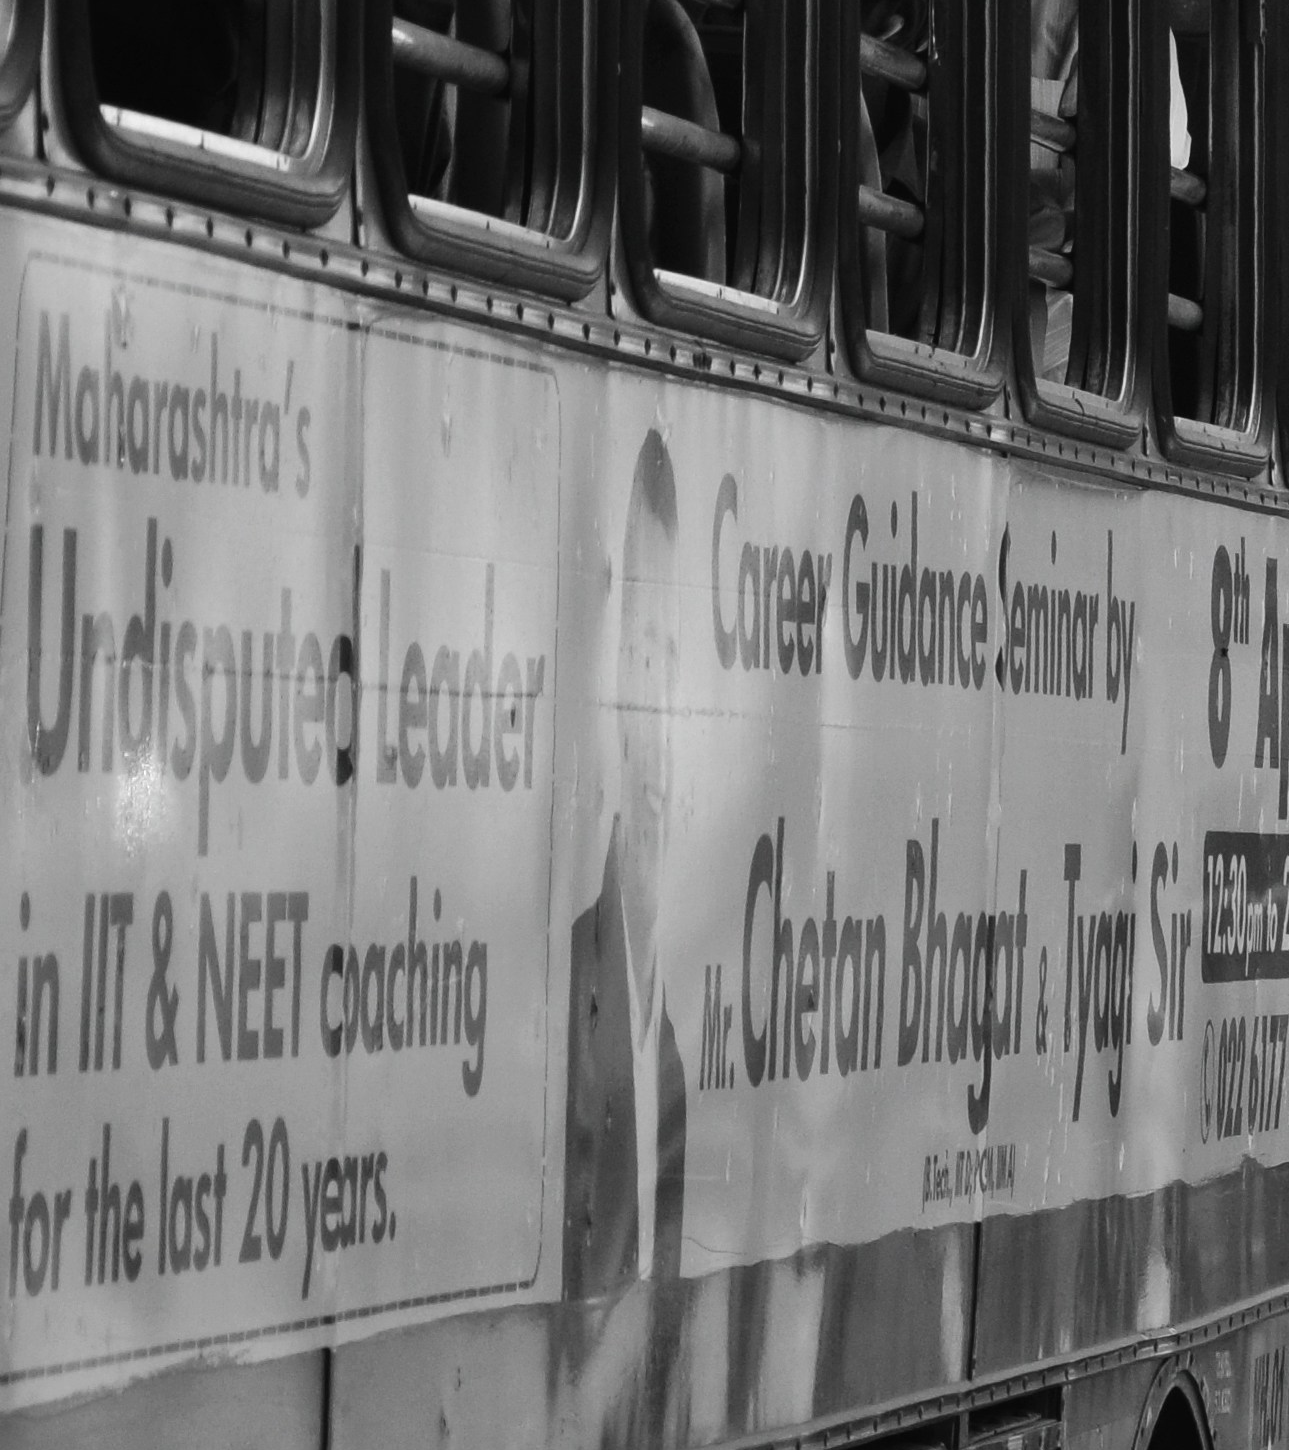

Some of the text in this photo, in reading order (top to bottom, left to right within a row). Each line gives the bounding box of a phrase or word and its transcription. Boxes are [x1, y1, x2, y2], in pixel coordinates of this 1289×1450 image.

[33, 303, 312, 497] Maharashtra's
[26, 516, 546, 858] Undisputed Leader
[711, 471, 1137, 756] Career Guidance Seminar by
[14, 876, 489, 1099] in IIT & NEET coaching
[698, 815, 1193, 1136] Mr. Chetan Bhagat & Tyagi Sir
[1266, 887, 1279, 953] to
[1216, 1015, 1247, 1142] 022
[1247, 1012, 1289, 1137] 6177
[9, 1116, 397, 1300] for the last 20 years.
